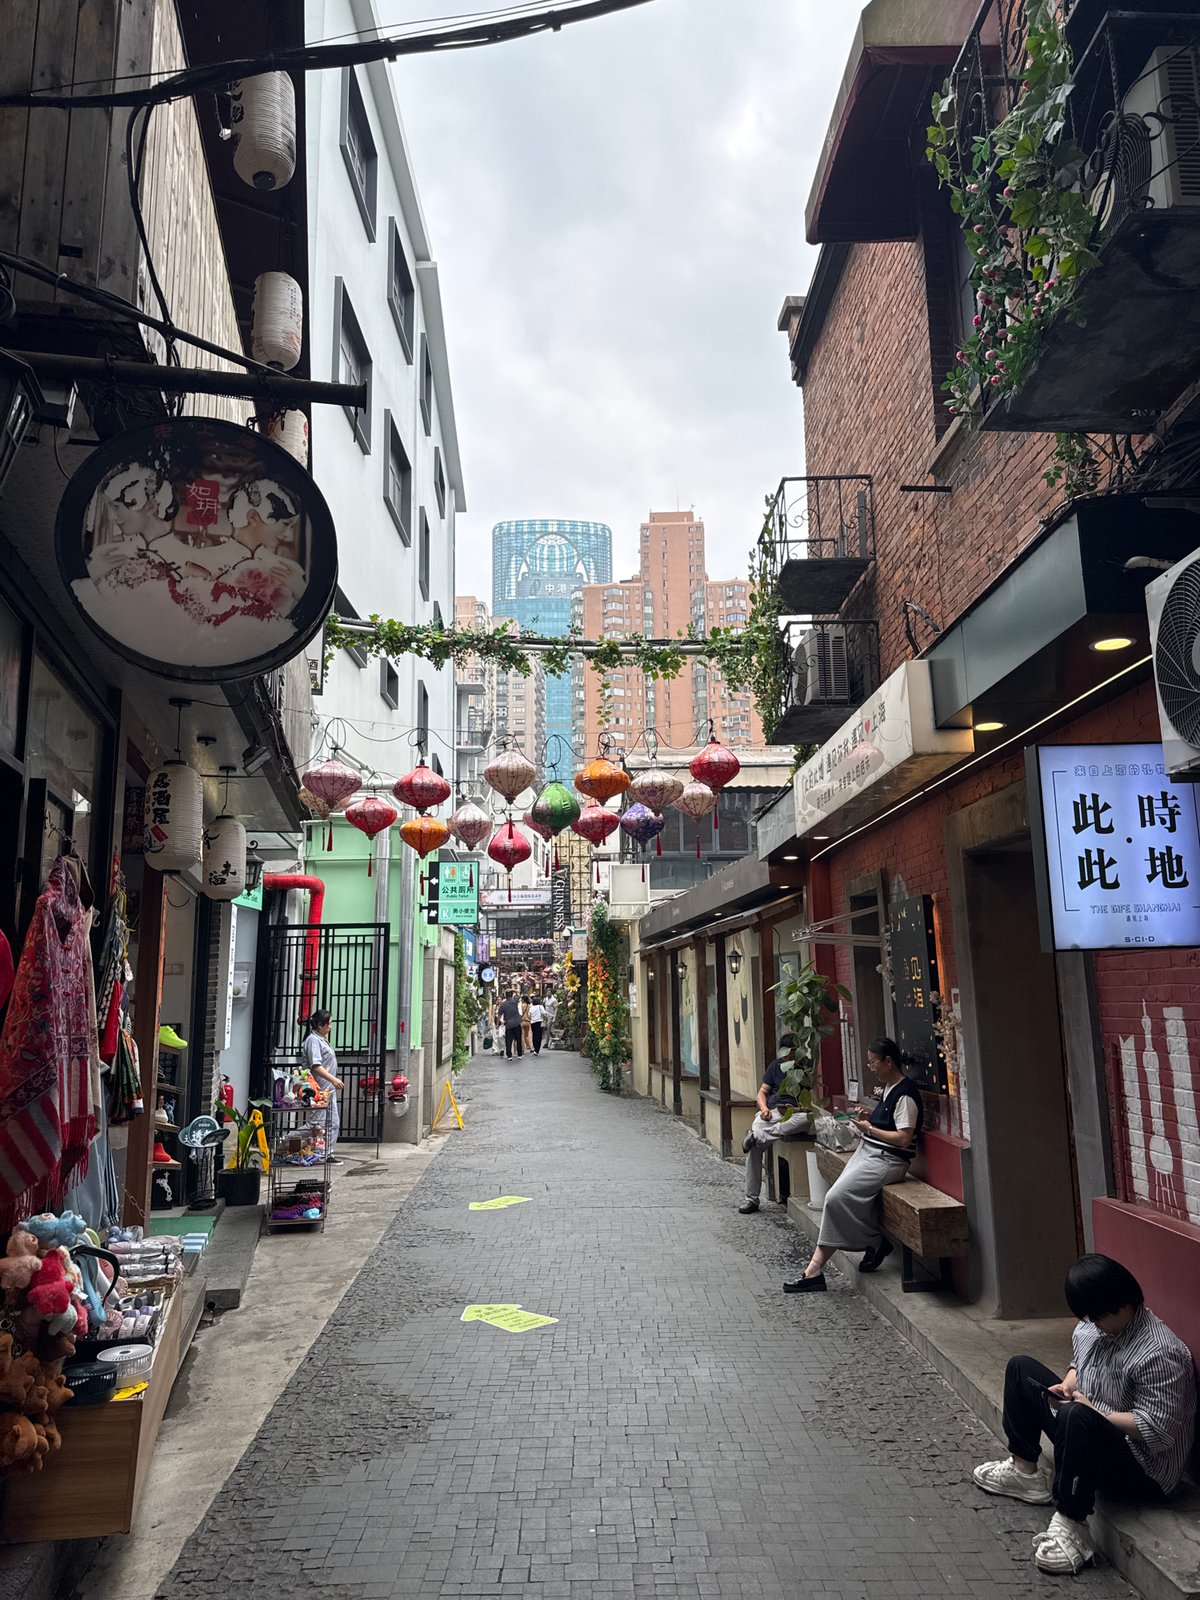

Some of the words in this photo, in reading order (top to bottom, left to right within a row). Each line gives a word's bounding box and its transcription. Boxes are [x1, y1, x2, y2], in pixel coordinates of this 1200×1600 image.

[186, 482, 222, 518] 如玥
[871, 701, 886, 733] 上海
[152, 772, 172, 826] 居酒屋
[441, 885, 475, 894] 公共厕所
[555, 879, 565, 931] GUINNESS
[1089, 905, 1109, 914] THE
[1134, 902, 1181, 914] SHANGHAI
